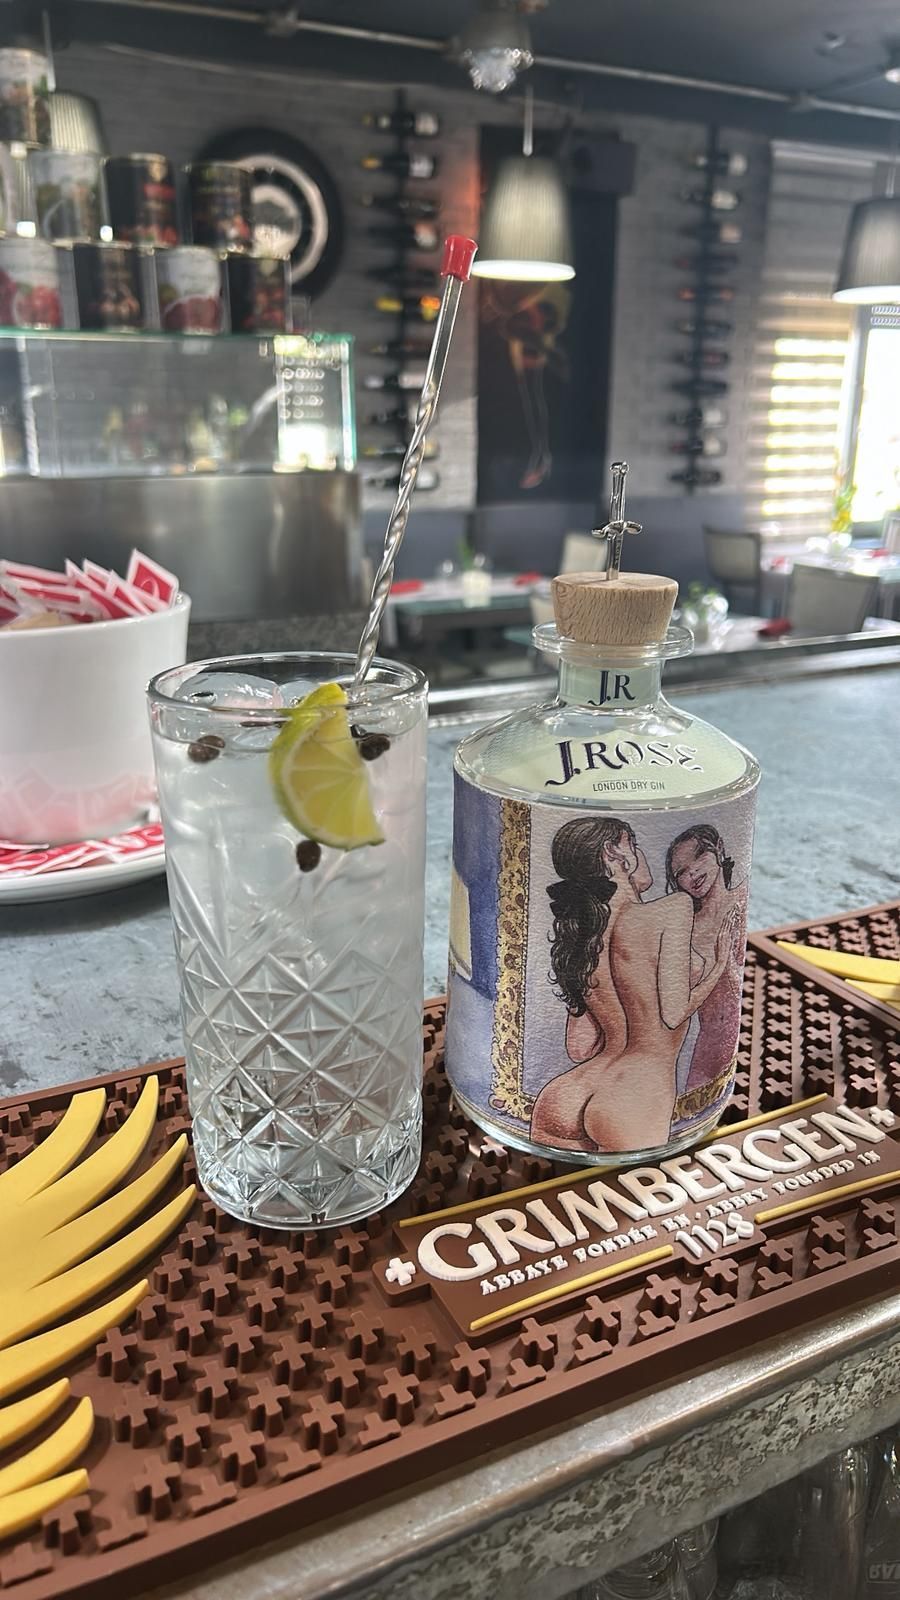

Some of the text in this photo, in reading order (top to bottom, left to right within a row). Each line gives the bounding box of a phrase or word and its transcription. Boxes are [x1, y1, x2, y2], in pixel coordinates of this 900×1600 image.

[588, 670, 636, 707] J.R
[545, 740, 704, 787] J.ROSE
[592, 780, 665, 793] LONDON DRY GIN
[416, 1105, 886, 1282] GRIMBERGEN
[705, 1150, 881, 1218] ABBEY FOUNDED IN
[479, 1213, 691, 1296] ABBAYE FONDÉE EN
[675, 1212, 755, 1259] 1128
